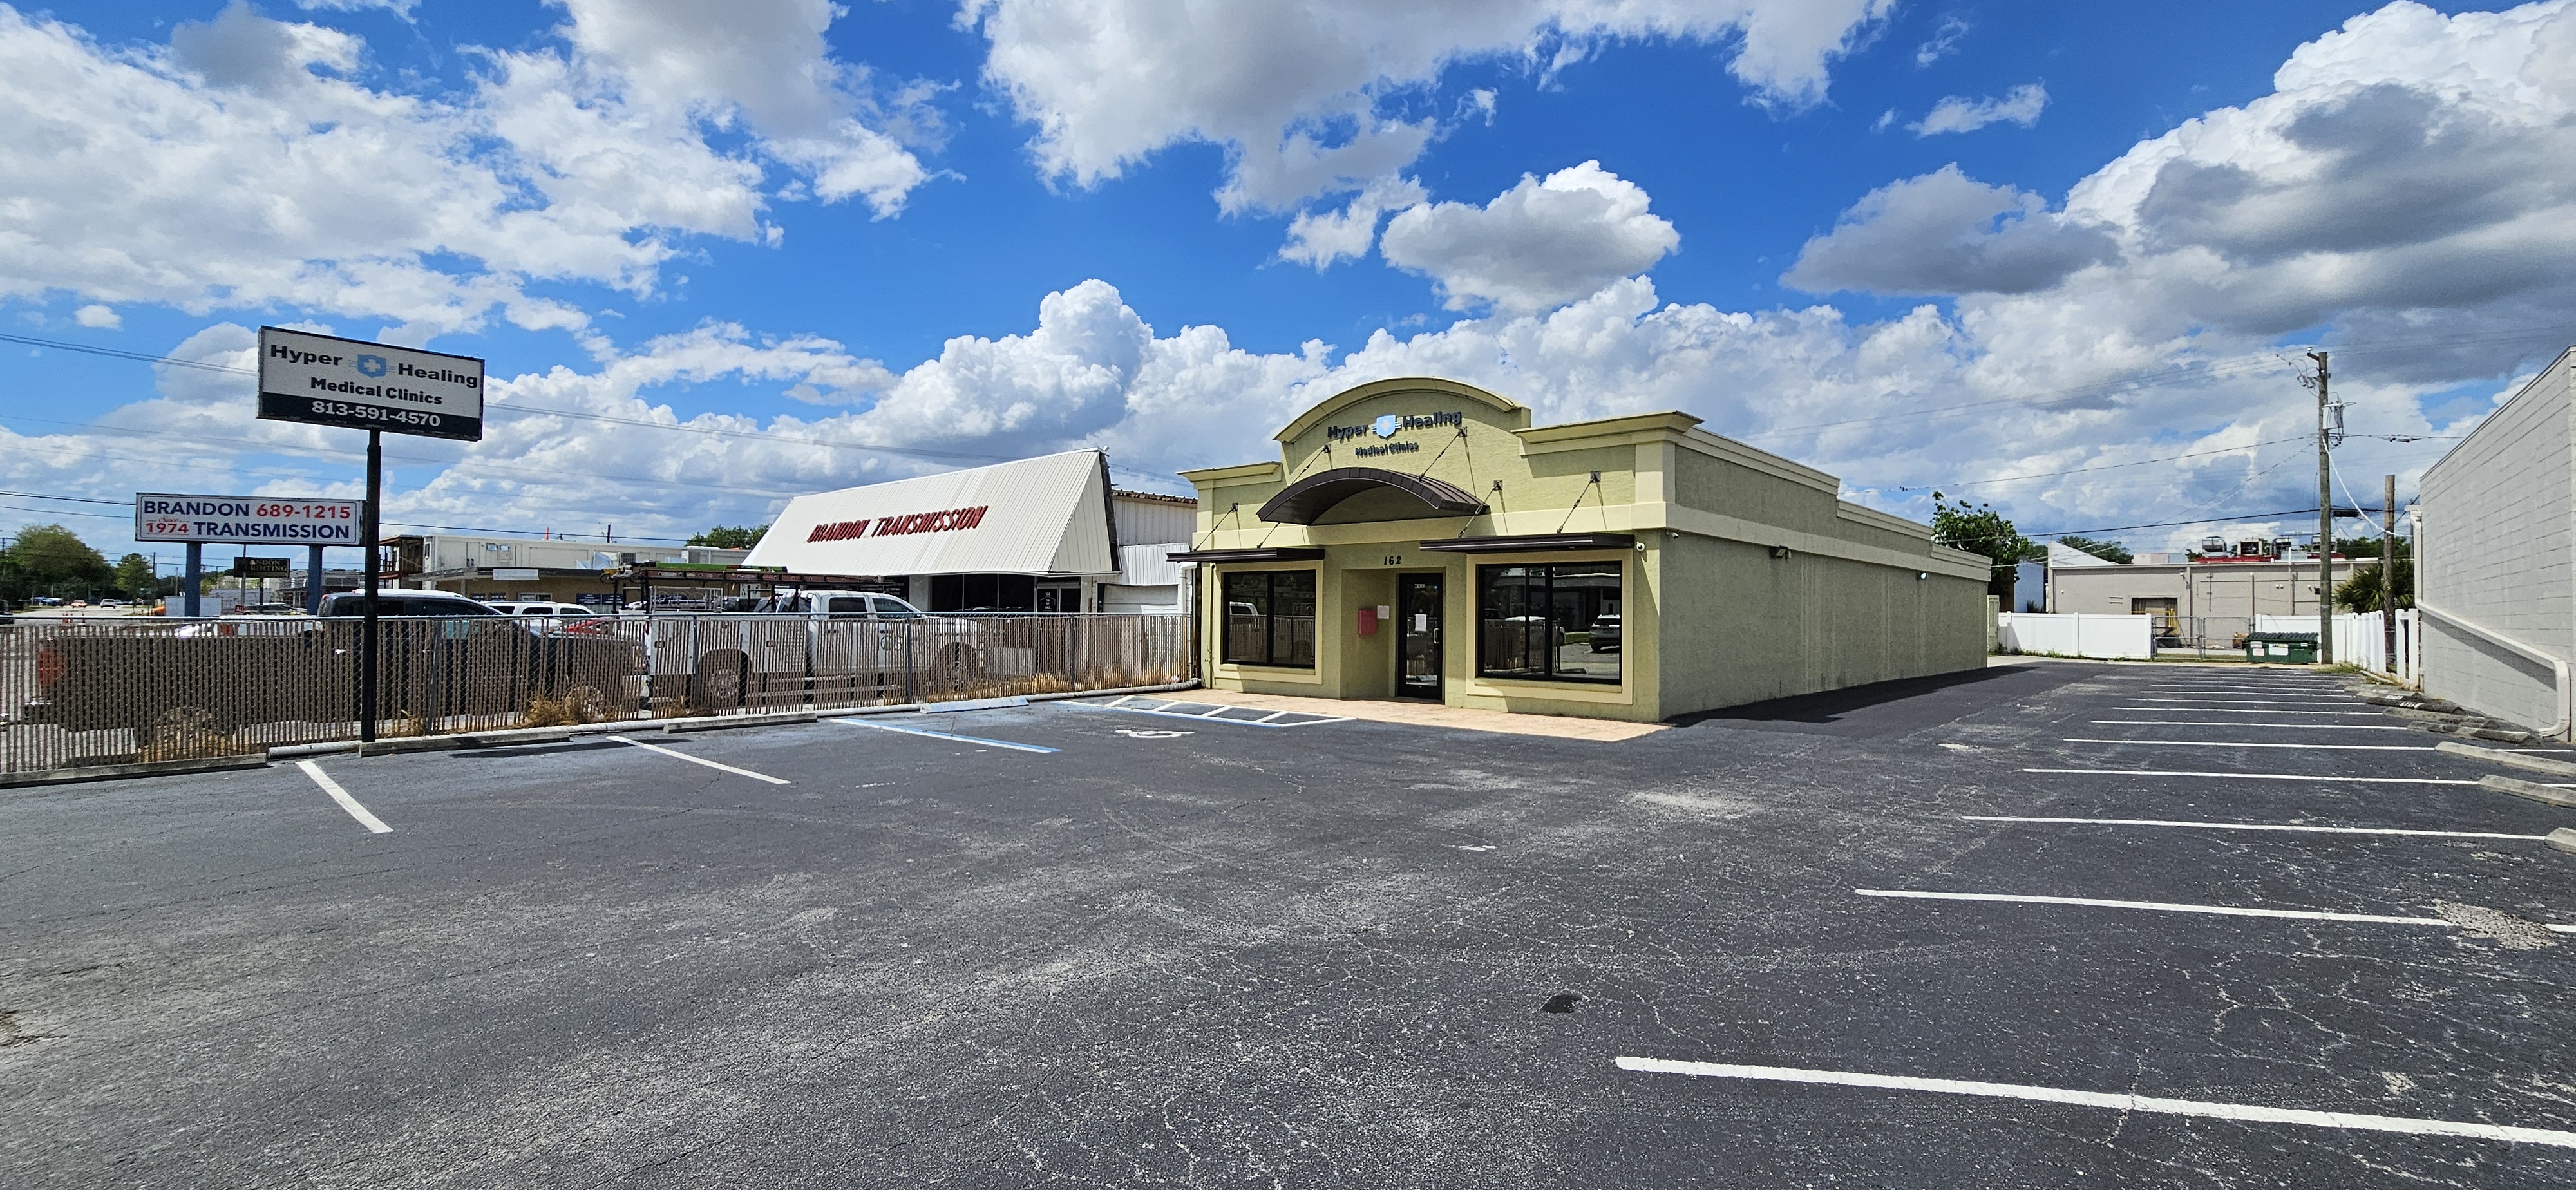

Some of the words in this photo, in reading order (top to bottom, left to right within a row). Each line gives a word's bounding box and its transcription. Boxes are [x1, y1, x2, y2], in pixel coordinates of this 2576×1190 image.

[270, 345, 343, 366] Hyper
[397, 363, 478, 388] Healing
[310, 377, 382, 397] Medical
[386, 386, 443, 405] Clinics
[312, 401, 441, 427] 813-591-4570
[1327, 424, 1369, 440] Hyper
[1402, 411, 1462, 428] Healing
[1355, 444, 1388, 457] Medical
[1388, 441, 1419, 455] Clinics
[144, 500, 250, 516] BRANDON
[256, 504, 351, 519] 689-1215
[146, 522, 189, 534] 1974
[193, 522, 350, 539] TRANSMISSION
[806, 519, 871, 543] BRANDON
[870, 505, 989, 538] TRANSMISSION
[1384, 556, 1402, 565] 162
